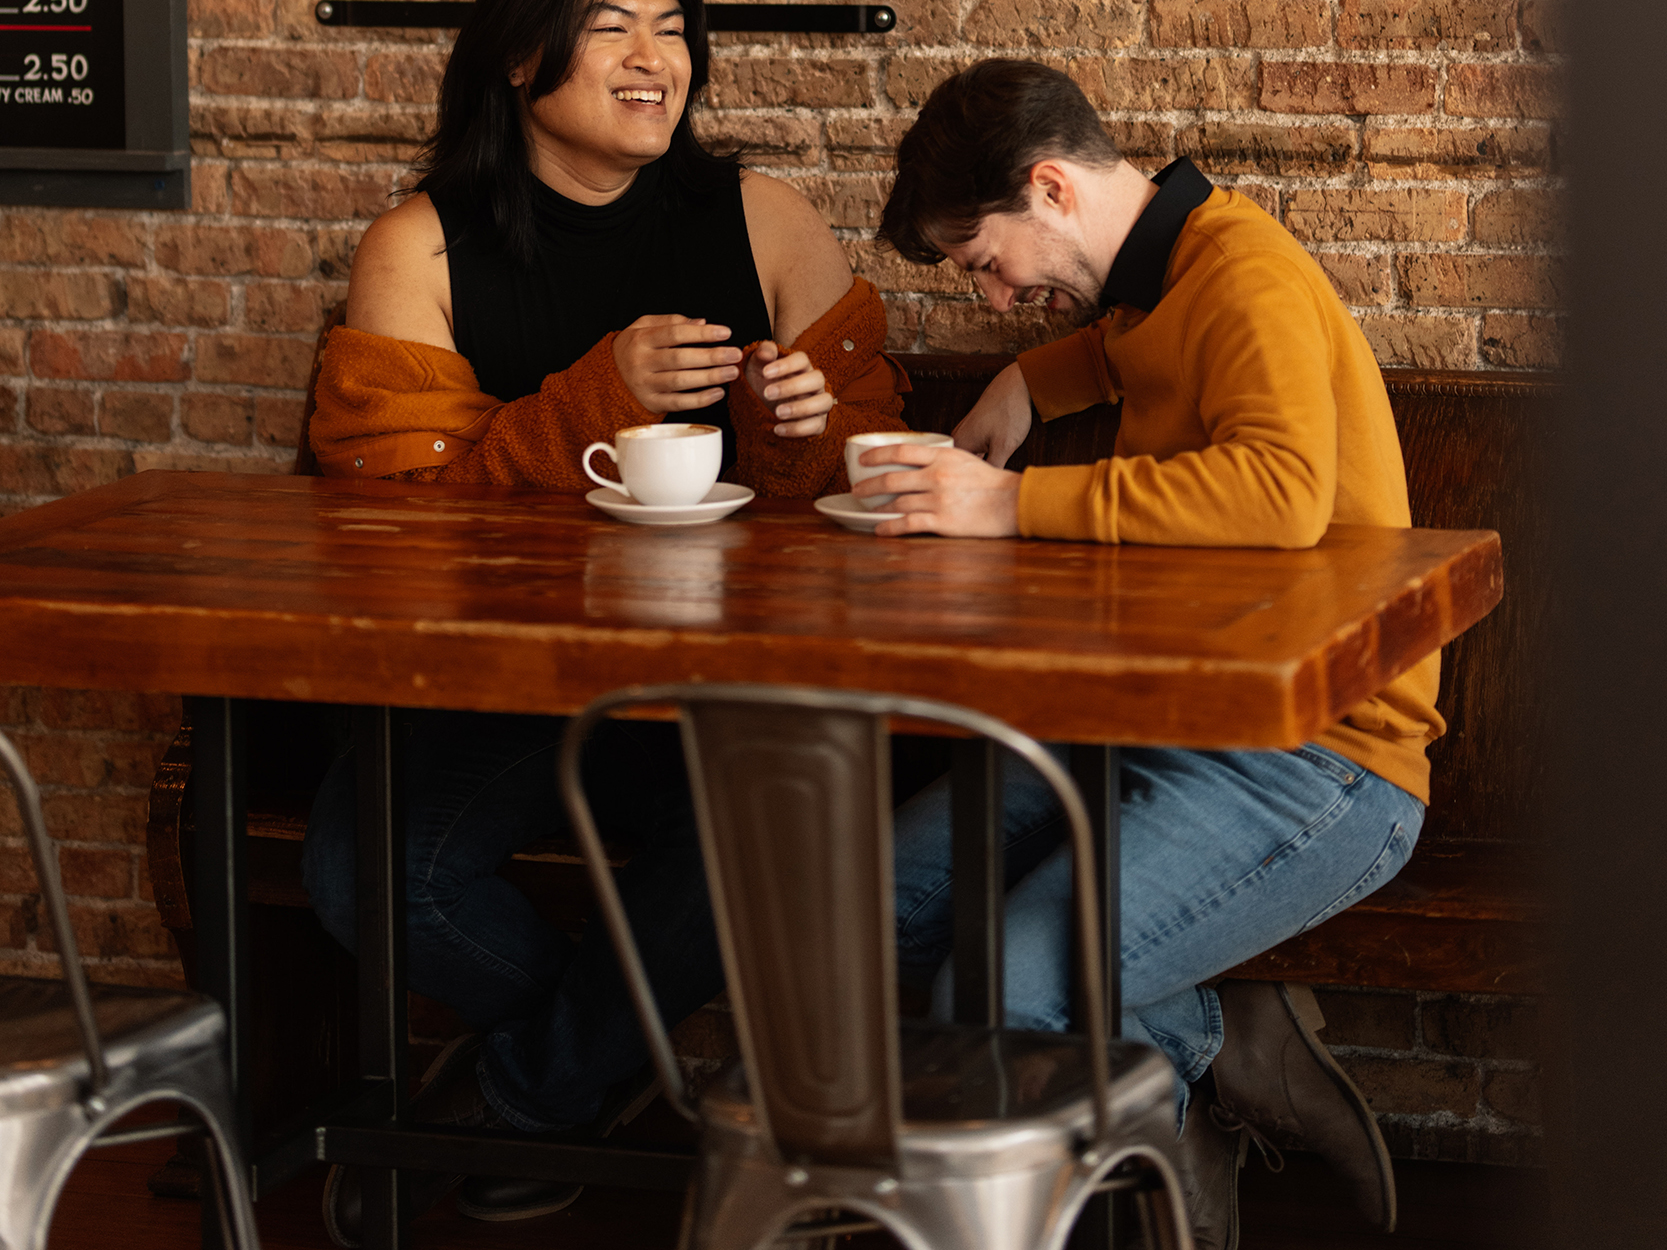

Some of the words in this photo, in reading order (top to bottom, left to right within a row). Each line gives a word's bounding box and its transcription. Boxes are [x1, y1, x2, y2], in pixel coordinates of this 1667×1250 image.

[24, 53, 88, 81] 2.50
[15, 87, 63, 104] CREAM
[68, 88, 93, 105] .50
